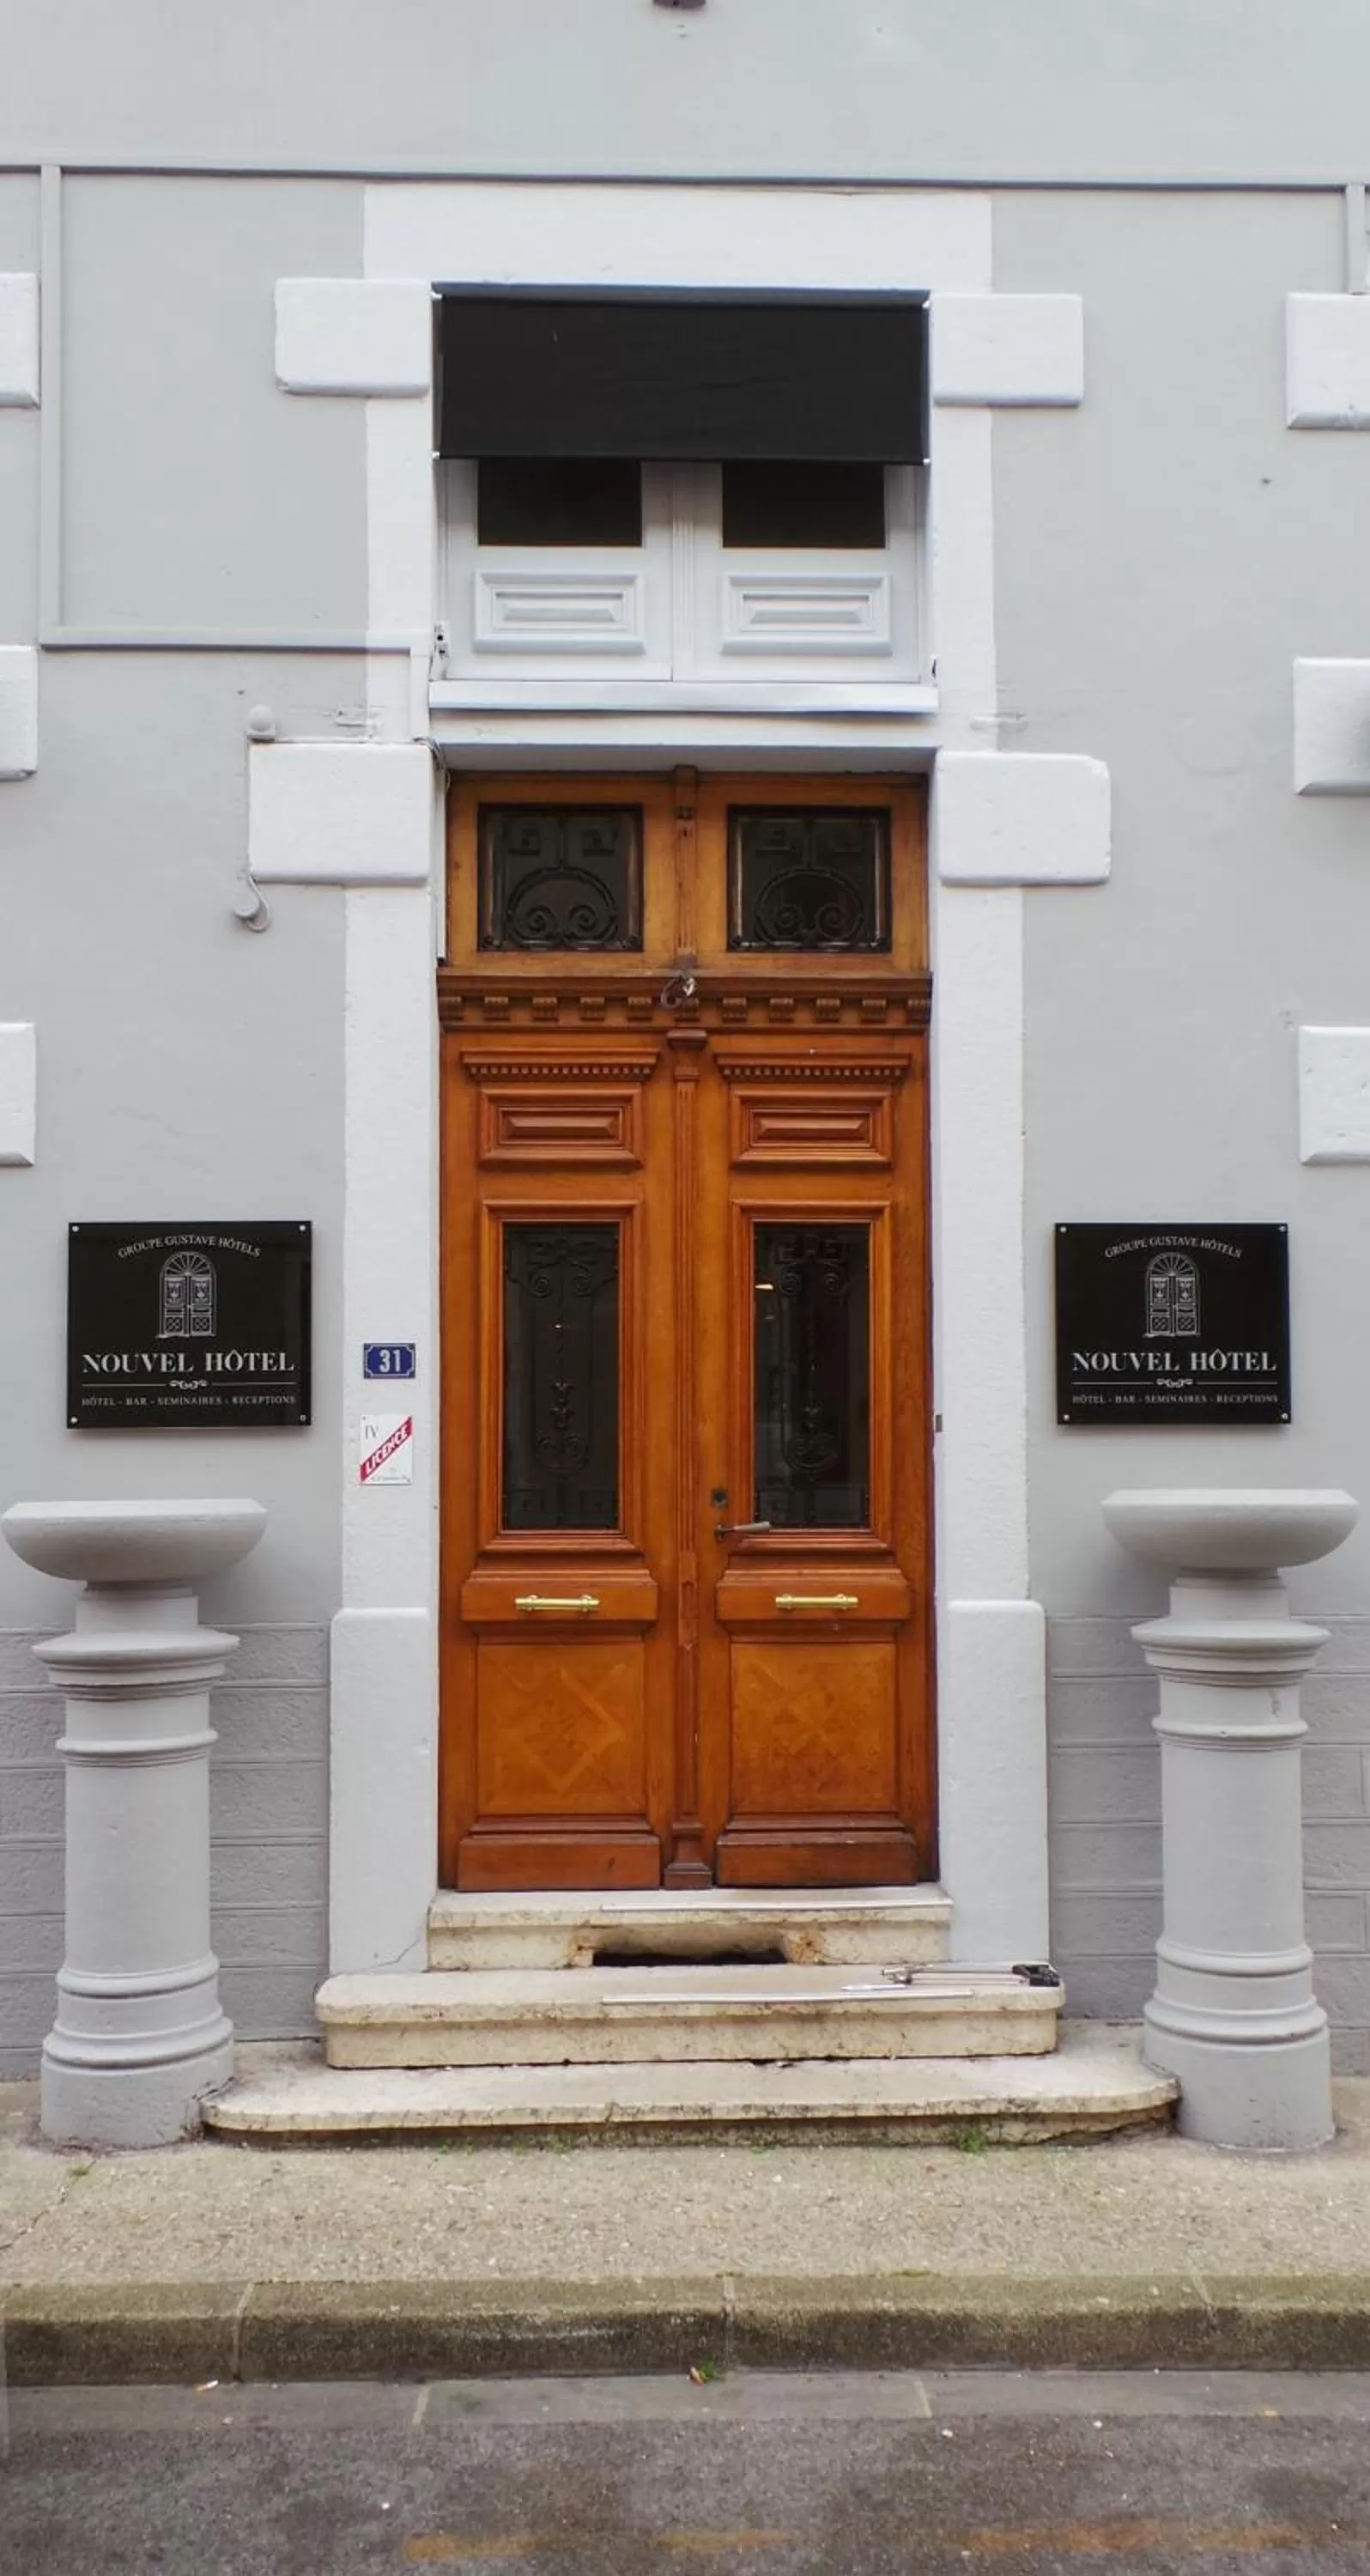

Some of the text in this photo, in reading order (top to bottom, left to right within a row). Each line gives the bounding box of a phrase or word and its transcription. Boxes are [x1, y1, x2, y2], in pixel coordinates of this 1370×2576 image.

[118, 1237, 163, 1258] GROUPE
[165, 1234, 215, 1246] GUSTAVE
[1105, 1237, 1147, 1258] GROUPE
[1149, 1236, 1197, 1247] GUSTAVE
[82, 1349, 294, 1373] NOUVEL HÔTEL
[379, 1349, 402, 1373] 31
[1072, 1348, 1276, 1372] NOUVEL HÔTEL
[126, 1396, 147, 1406] BAR
[1116, 1394, 1135, 1404] BAR
[365, 1425, 379, 1440] IV
[365, 1424, 408, 1475] LICENCE
